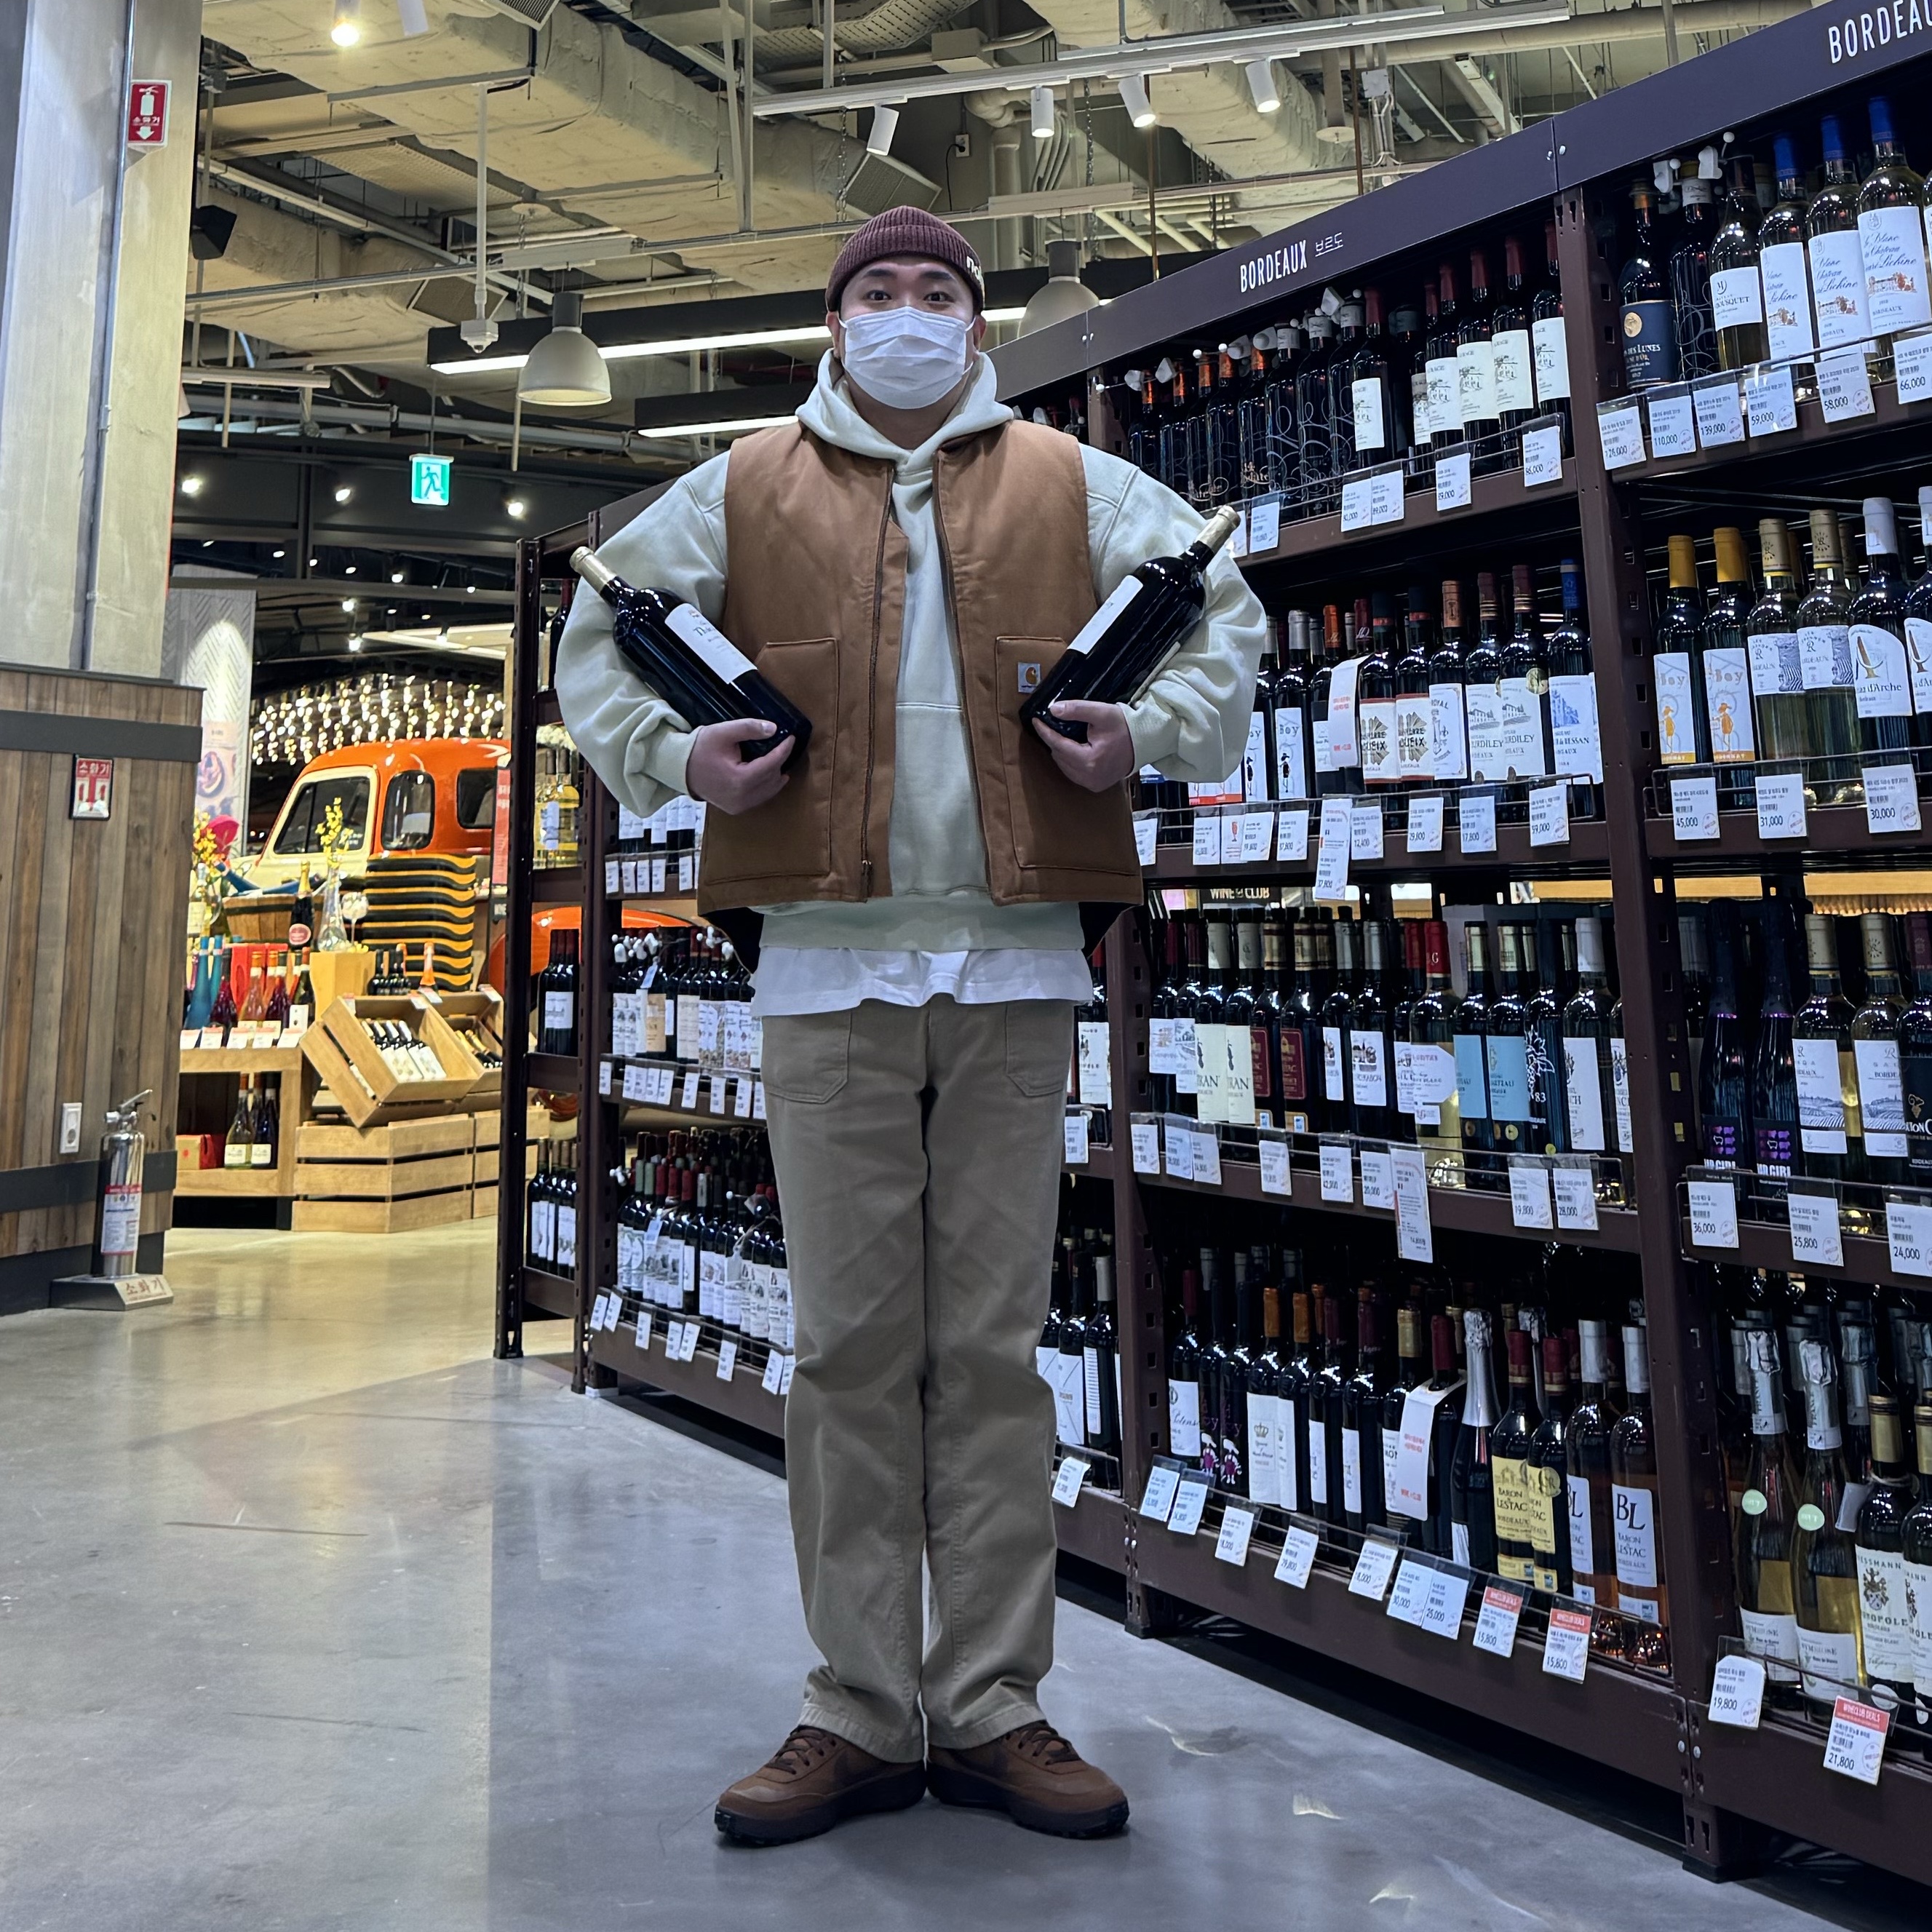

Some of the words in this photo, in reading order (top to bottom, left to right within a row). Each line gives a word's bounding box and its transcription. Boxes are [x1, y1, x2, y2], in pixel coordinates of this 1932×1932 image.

[1240, 239, 1307, 293] BORDEAUX
[1315, 232, 1343, 257] 보르도
[1900, 376, 1926, 391] 66,000
[1824, 396, 1848, 411] 58,000
[1752, 411, 1774, 426] 59,000
[1700, 422, 1725, 436] 139,000
[1654, 434, 1678, 446] 110,000
[79, 762, 110, 774] 소화기
[1760, 815, 1783, 827] 31,000
[1871, 808, 1896, 820] 30,000
[1676, 816, 1698, 829] 45,000
[1209, 888, 1235, 899] WINE
[1244, 887, 1270, 899] CLUB
[1535, 1092, 1546, 1102] 83
[1693, 1223, 1716, 1235] 36,000
[1794, 1236, 1817, 1249] 25,800
[1893, 1246, 1920, 1260] 24,000
[125, 1277, 164, 1296] 소화기
[1498, 1487, 1523, 1498] BARON
[1496, 1498, 1528, 1511] LESTAC
[1615, 1493, 1646, 1530] BL
[1617, 1543, 1647, 1559] LESTAC
[1476, 1631, 1498, 1647] 15,800
[1546, 1655, 1568, 1669] 15,800
[1712, 1696, 1738, 1711] 19,800
[1828, 1752, 1855, 1770] 21,800
